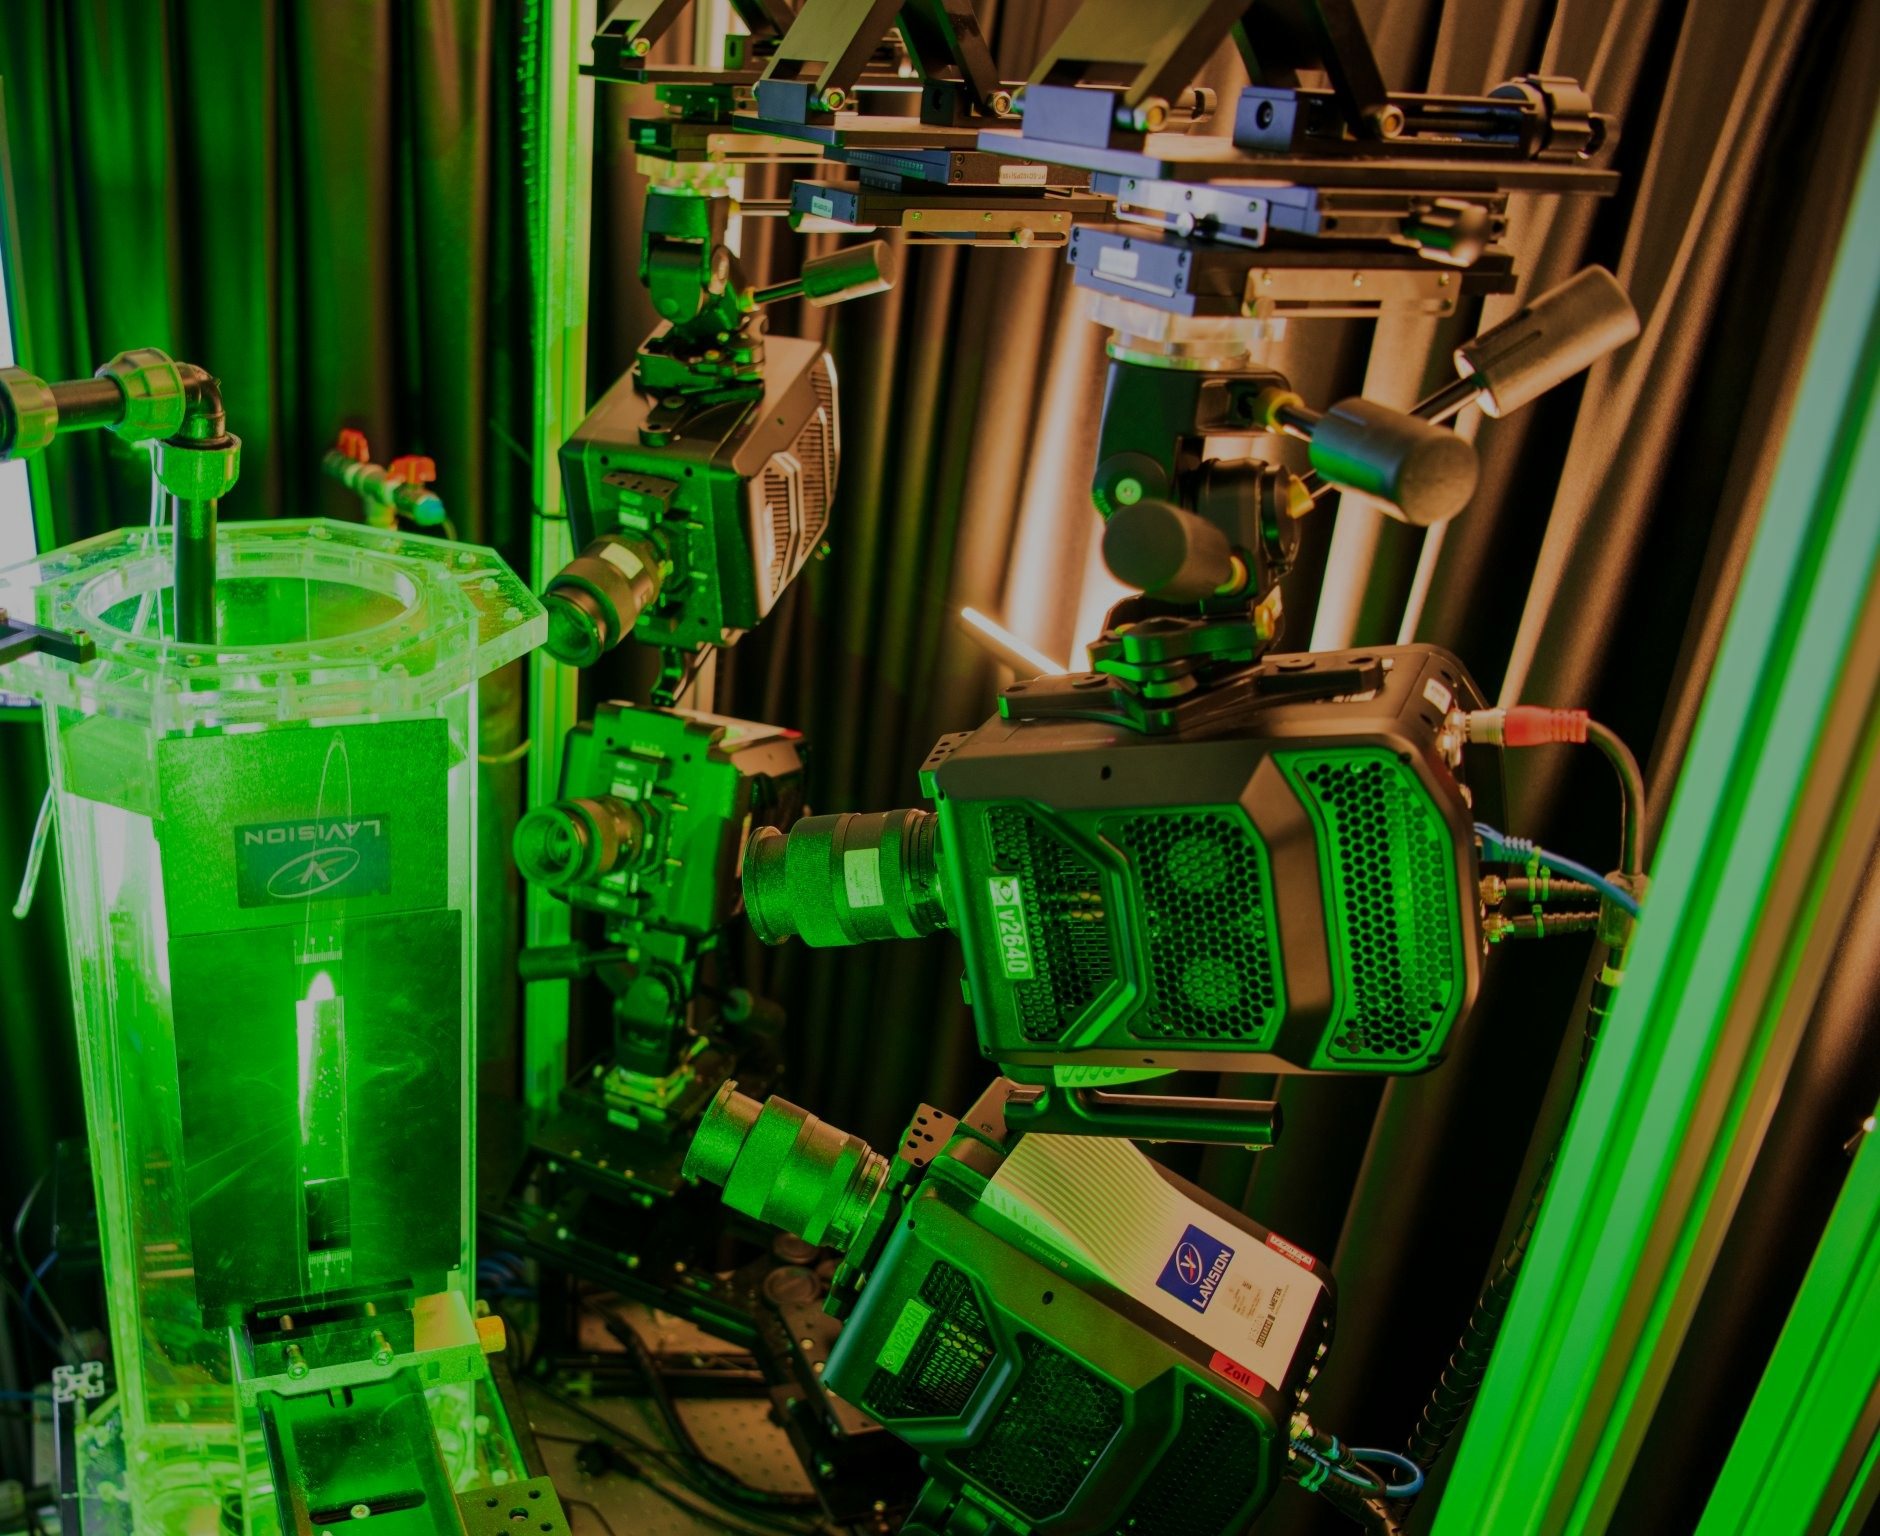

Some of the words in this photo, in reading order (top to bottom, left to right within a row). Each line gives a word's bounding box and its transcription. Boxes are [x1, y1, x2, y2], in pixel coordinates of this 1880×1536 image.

[245, 820, 381, 846] LAVISION
[1192, 1249, 1231, 1309] LAVISION
[1223, 1363, 1251, 1386] Zoll
